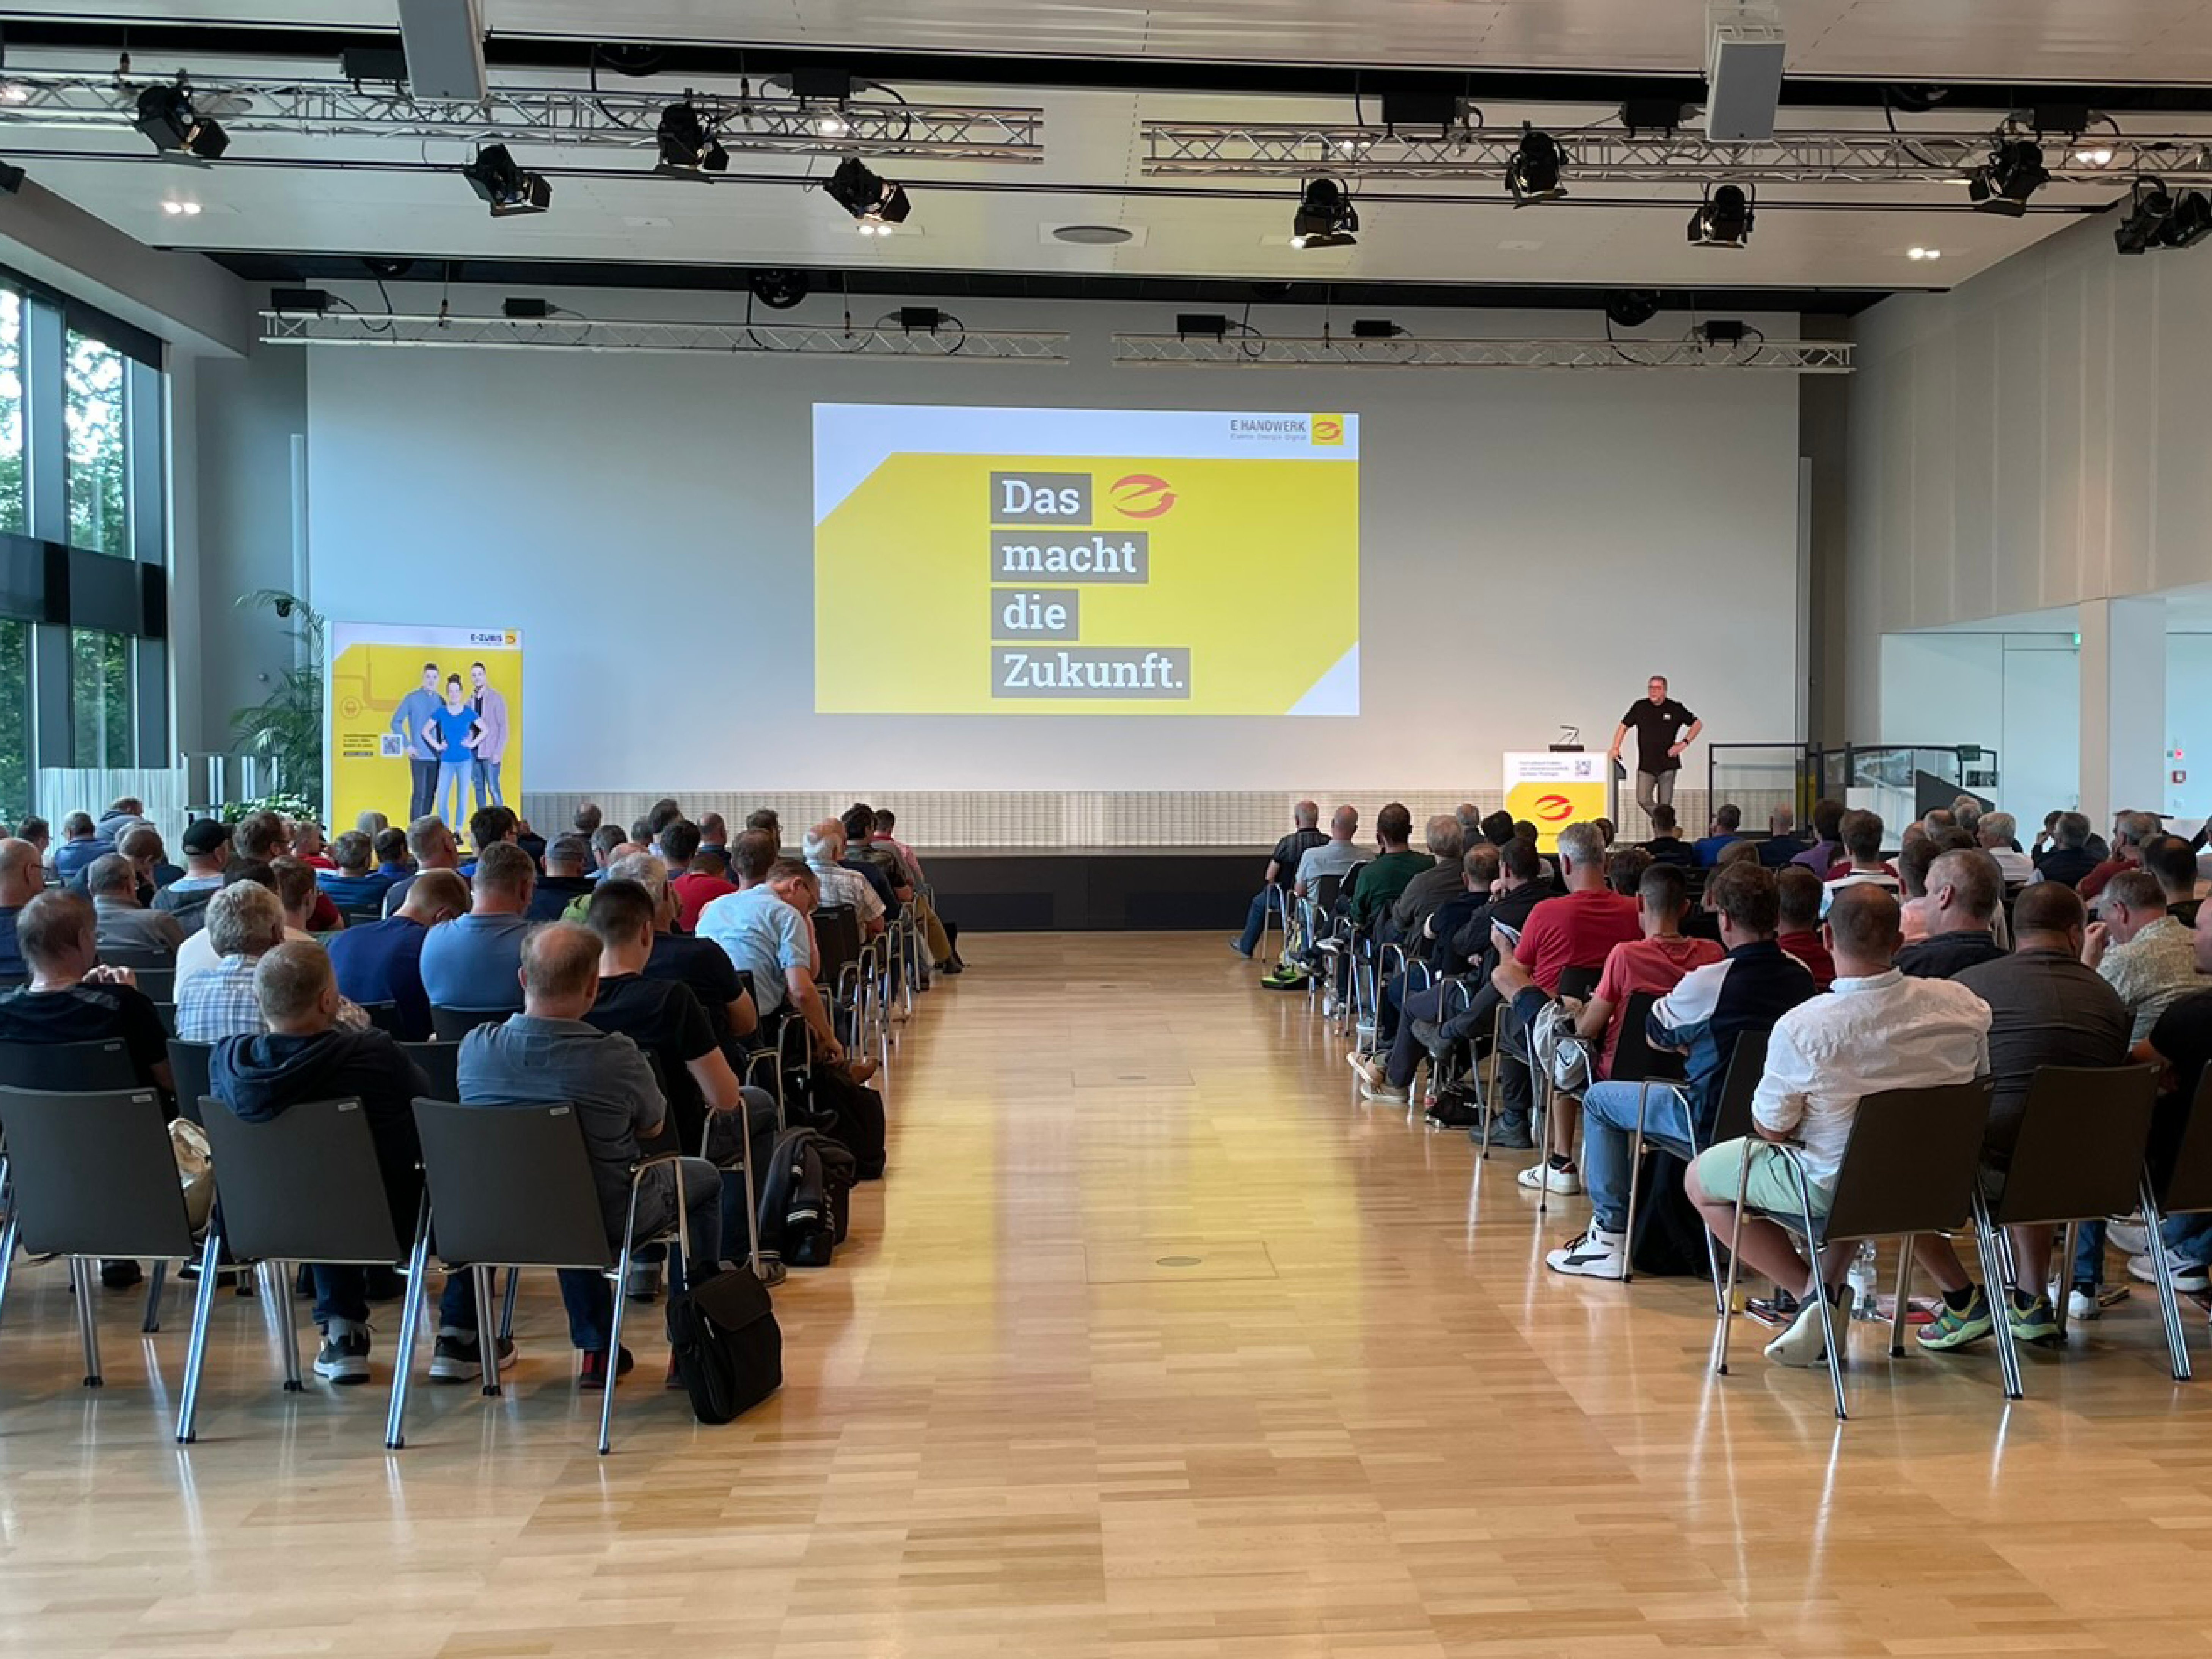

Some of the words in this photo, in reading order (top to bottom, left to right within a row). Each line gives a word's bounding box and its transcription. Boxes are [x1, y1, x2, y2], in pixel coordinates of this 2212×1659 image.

[1231, 420, 1238, 431] E
[1241, 420, 1306, 432] HANDWERK
[1002, 479, 1080, 515] Das
[1002, 536, 1137, 572] macht
[1003, 593, 1067, 629] die
[1003, 652, 1183, 689] Zukunft.
